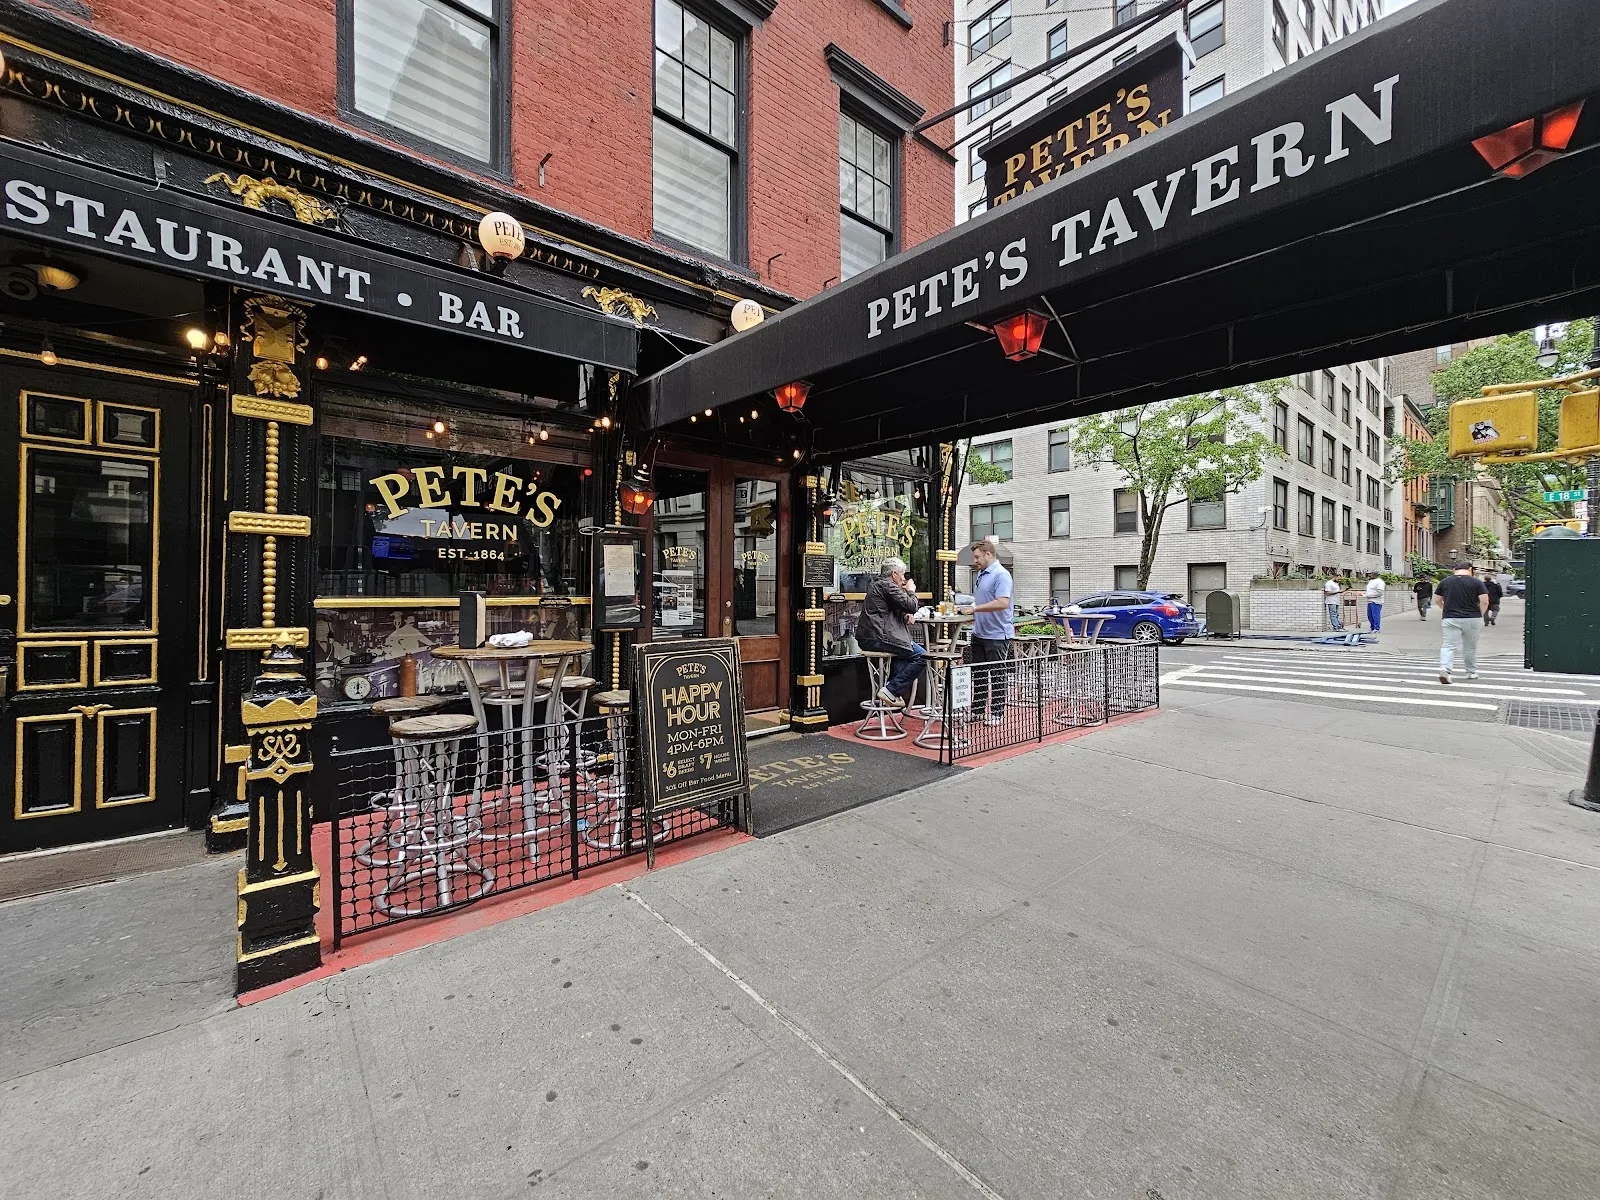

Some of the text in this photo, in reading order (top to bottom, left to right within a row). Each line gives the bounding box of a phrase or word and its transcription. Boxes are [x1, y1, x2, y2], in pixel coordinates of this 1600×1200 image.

[1004, 84, 1151, 187] PETE'S
[866, 74, 1400, 339] PETE'S TAVERN
[5, 179, 524, 340] STAURANT BAR
[369, 465, 562, 528] PETE'S
[1549, 492, 1555, 501] E
[1558, 492, 1570, 500] 18
[420, 519, 518, 541] TAVERN
[841, 511, 916, 549] PETE'S
[438, 547, 505, 561] EST. 1864
[662, 546, 697, 560] PETE'S
[741, 550, 769, 562] PETE'S
[859, 544, 898, 557] TAVERN
[676, 662, 707, 677] PETE'S
[661, 681, 722, 707] HAPPY
[667, 701, 720, 727] HOUR
[667, 724, 723, 743] MON-FRI
[667, 735, 724, 755] 4PM-6PM
[662, 760, 677, 778] $6
[700, 752, 712, 769] $7
[750, 752, 856, 790] ETE'S
[772, 766, 845, 788] TAVERN
